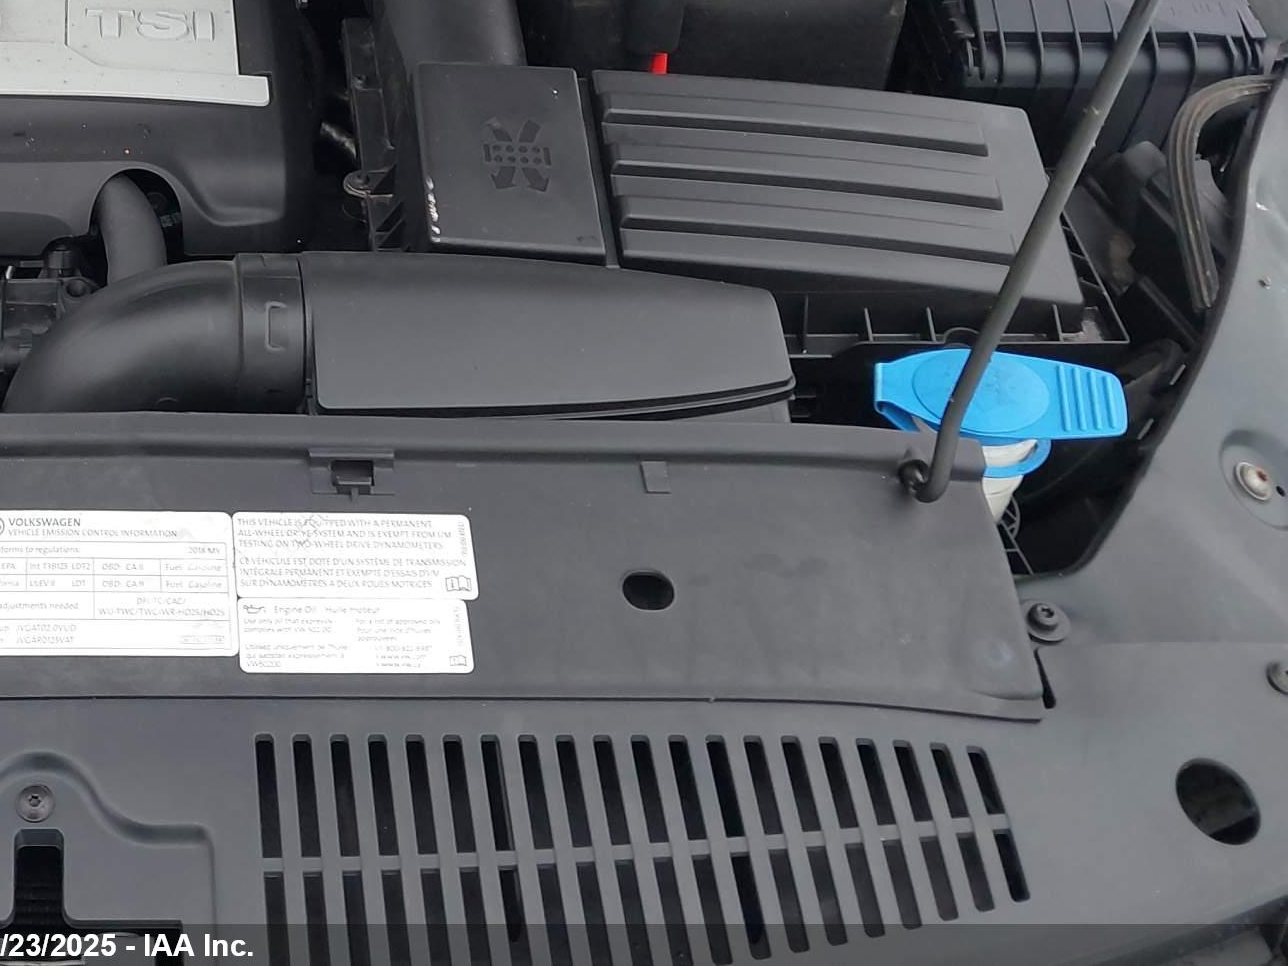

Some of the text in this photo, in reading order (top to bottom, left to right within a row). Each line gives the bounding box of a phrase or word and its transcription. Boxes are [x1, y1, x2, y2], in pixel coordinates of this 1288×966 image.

[85, 7, 215, 42] TSI
[8, 517, 81, 527] VOLKSWAGEN
[258, 518, 294, 526] VEHICLE
[8, 529, 178, 538] VEHICLE EMISSION CONTROL INFORMATION
[25, 545, 34, 554] to
